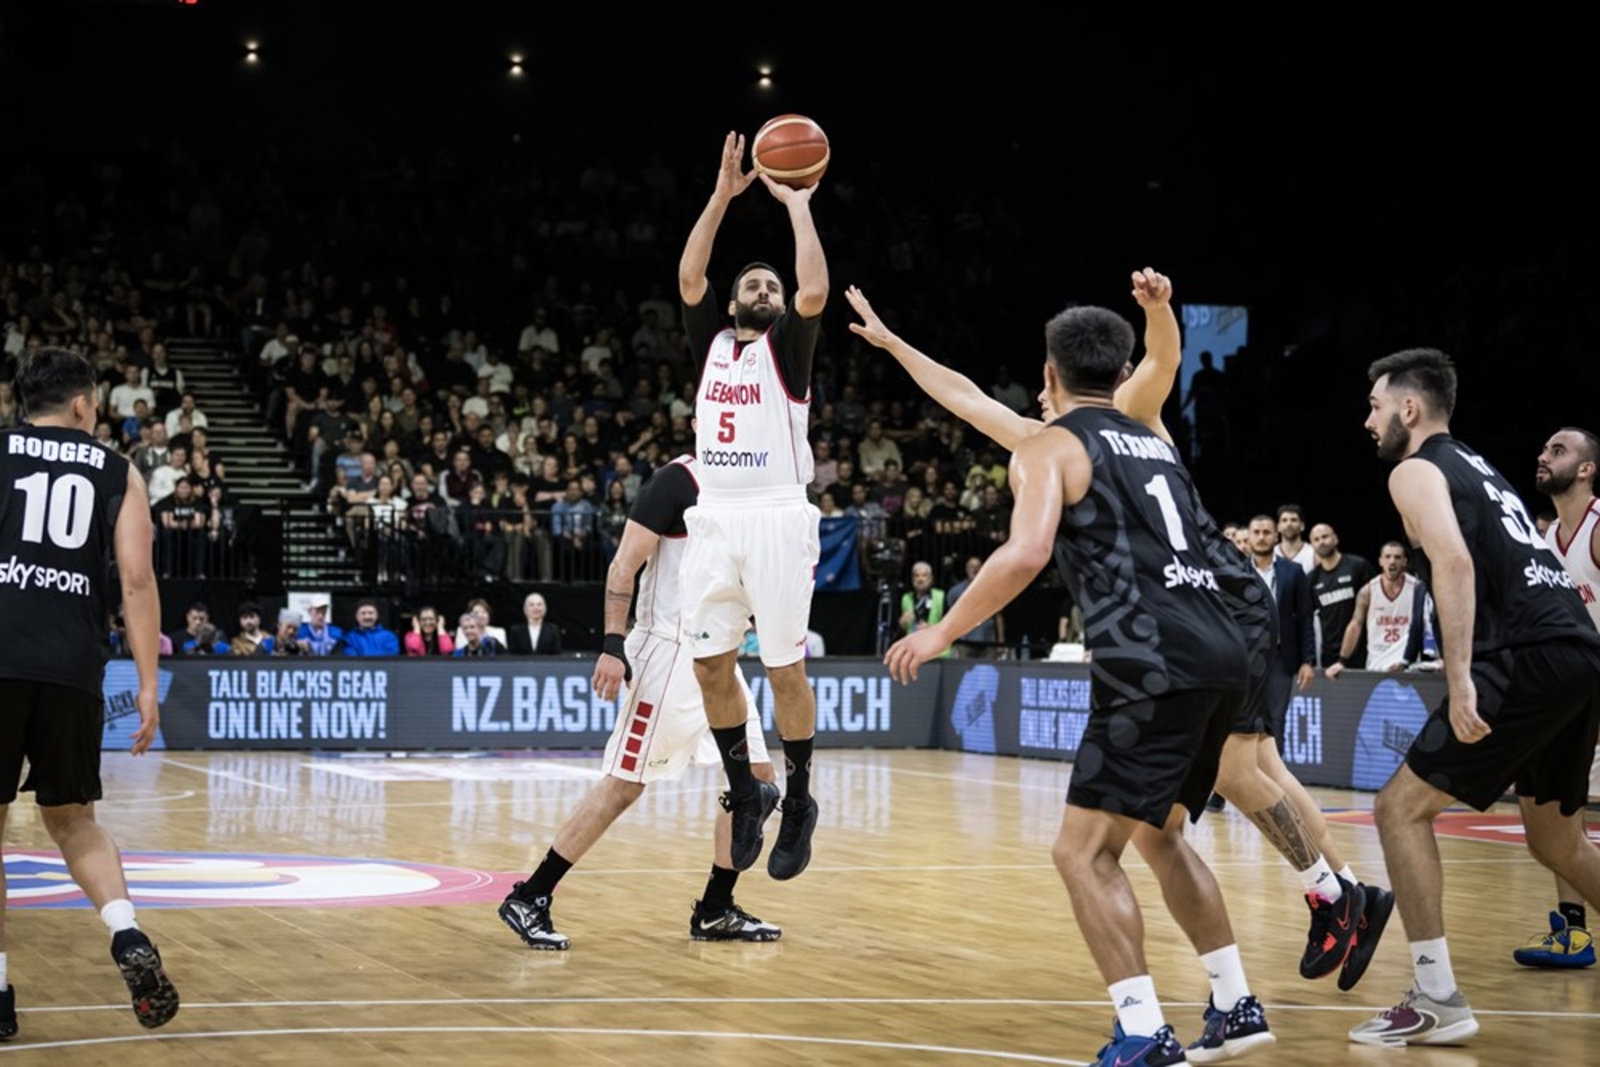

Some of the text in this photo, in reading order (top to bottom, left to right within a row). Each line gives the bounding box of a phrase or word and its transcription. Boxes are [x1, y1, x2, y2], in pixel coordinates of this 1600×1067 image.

[717, 412, 735, 443] 5
[8, 434, 106, 470] RODGER
[14, 471, 95, 549] 10
[1144, 474, 1188, 551] 1
[0, 555, 35, 589] sky
[1384, 628, 1400, 643] 25
[208, 670, 387, 699] TALL BLACKS GEAR
[208, 701, 387, 739] ONLINE NOW!
